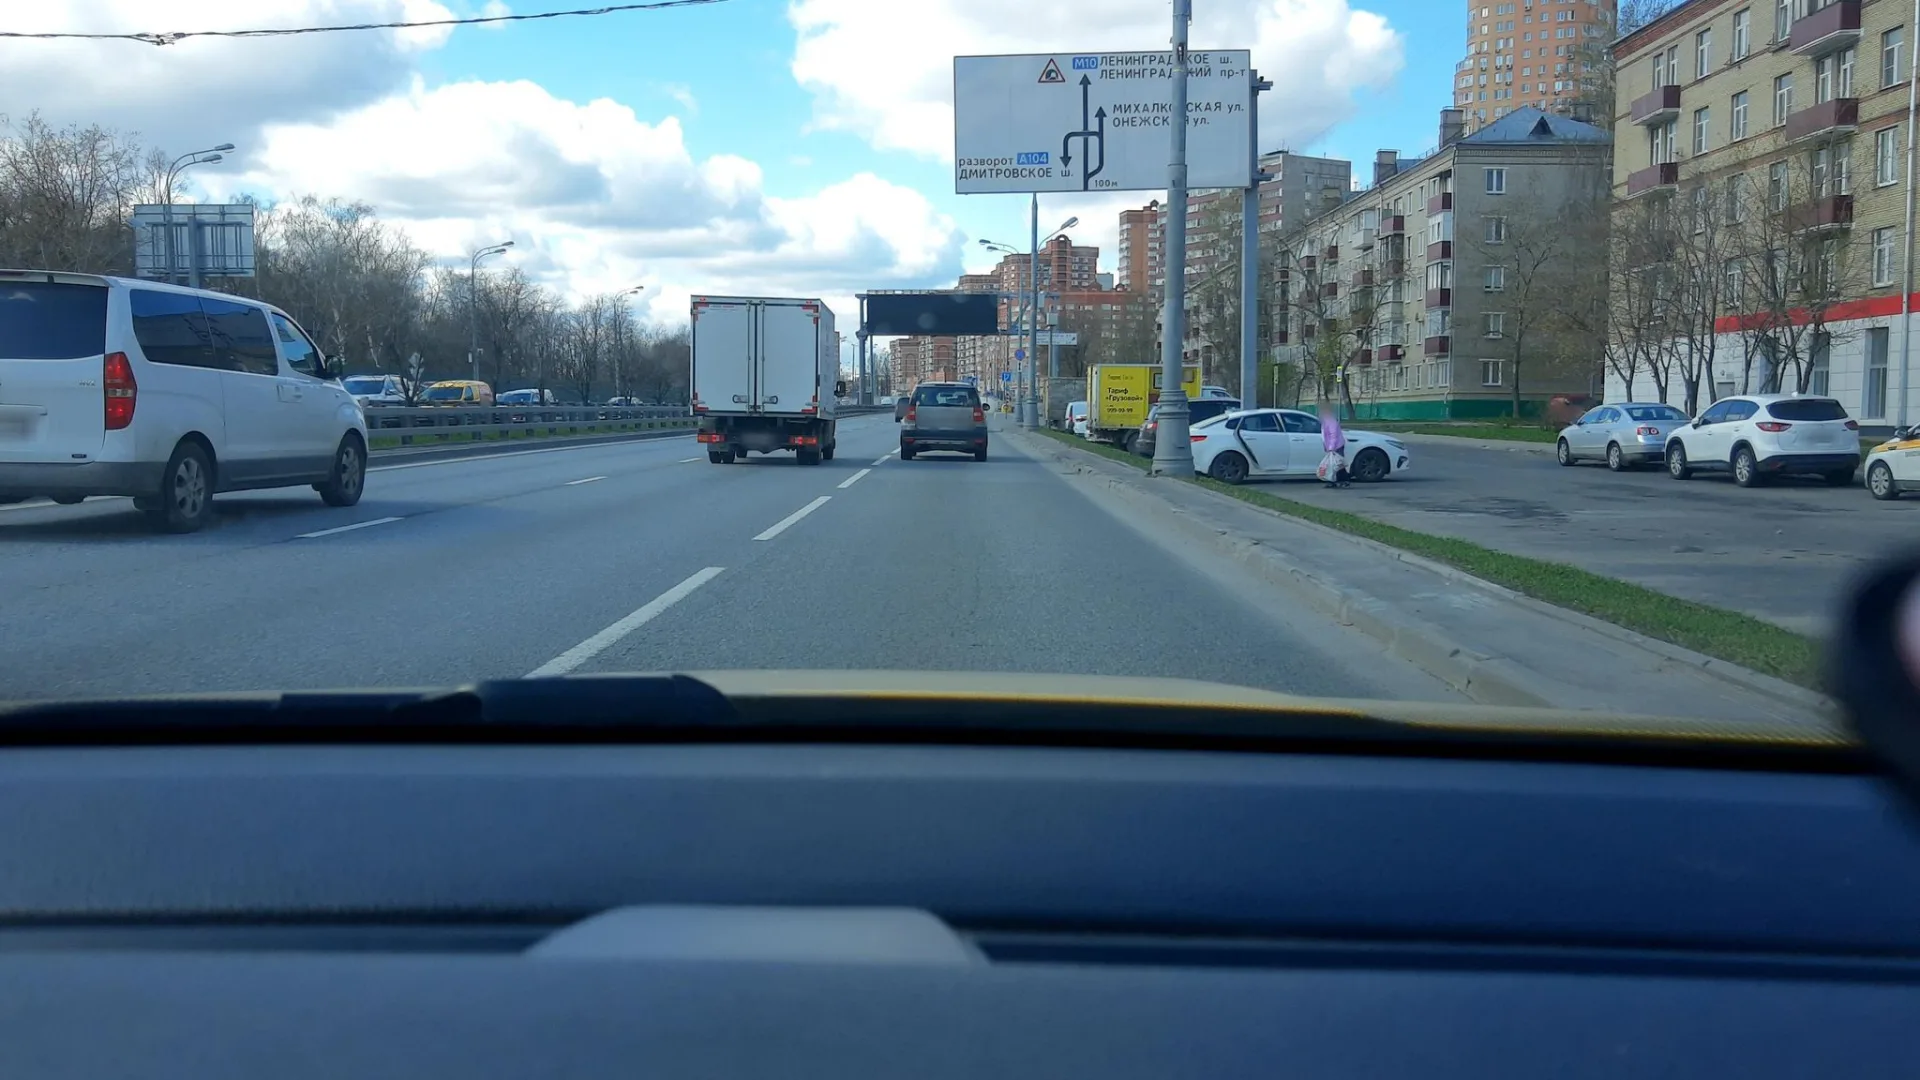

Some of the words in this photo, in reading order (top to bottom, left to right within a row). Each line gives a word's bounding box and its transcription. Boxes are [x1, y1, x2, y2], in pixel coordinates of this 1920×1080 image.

[1100, 54, 1209, 66] ЛЕНИНГРАДКОЕ
[1220, 56, 1233, 64] ш.
[1100, 65, 1211, 79] ЛЕНИНГРАДКИЙ
[1220, 69, 1245, 79] пр-т
[1113, 102, 1221, 114] МИХАЛКСКАЯ
[1228, 103, 1244, 114] ул.
[1113, 116, 1189, 128] ОНЕЖСКЯ
[1193, 117, 1210, 127] ул.
[959, 156, 1013, 168] разворот
[959, 168, 1052, 180] ДМИТРОВСКОЕ
[1060, 169, 1074, 178] ш.
[1107, 387, 1128, 395] Тариф
